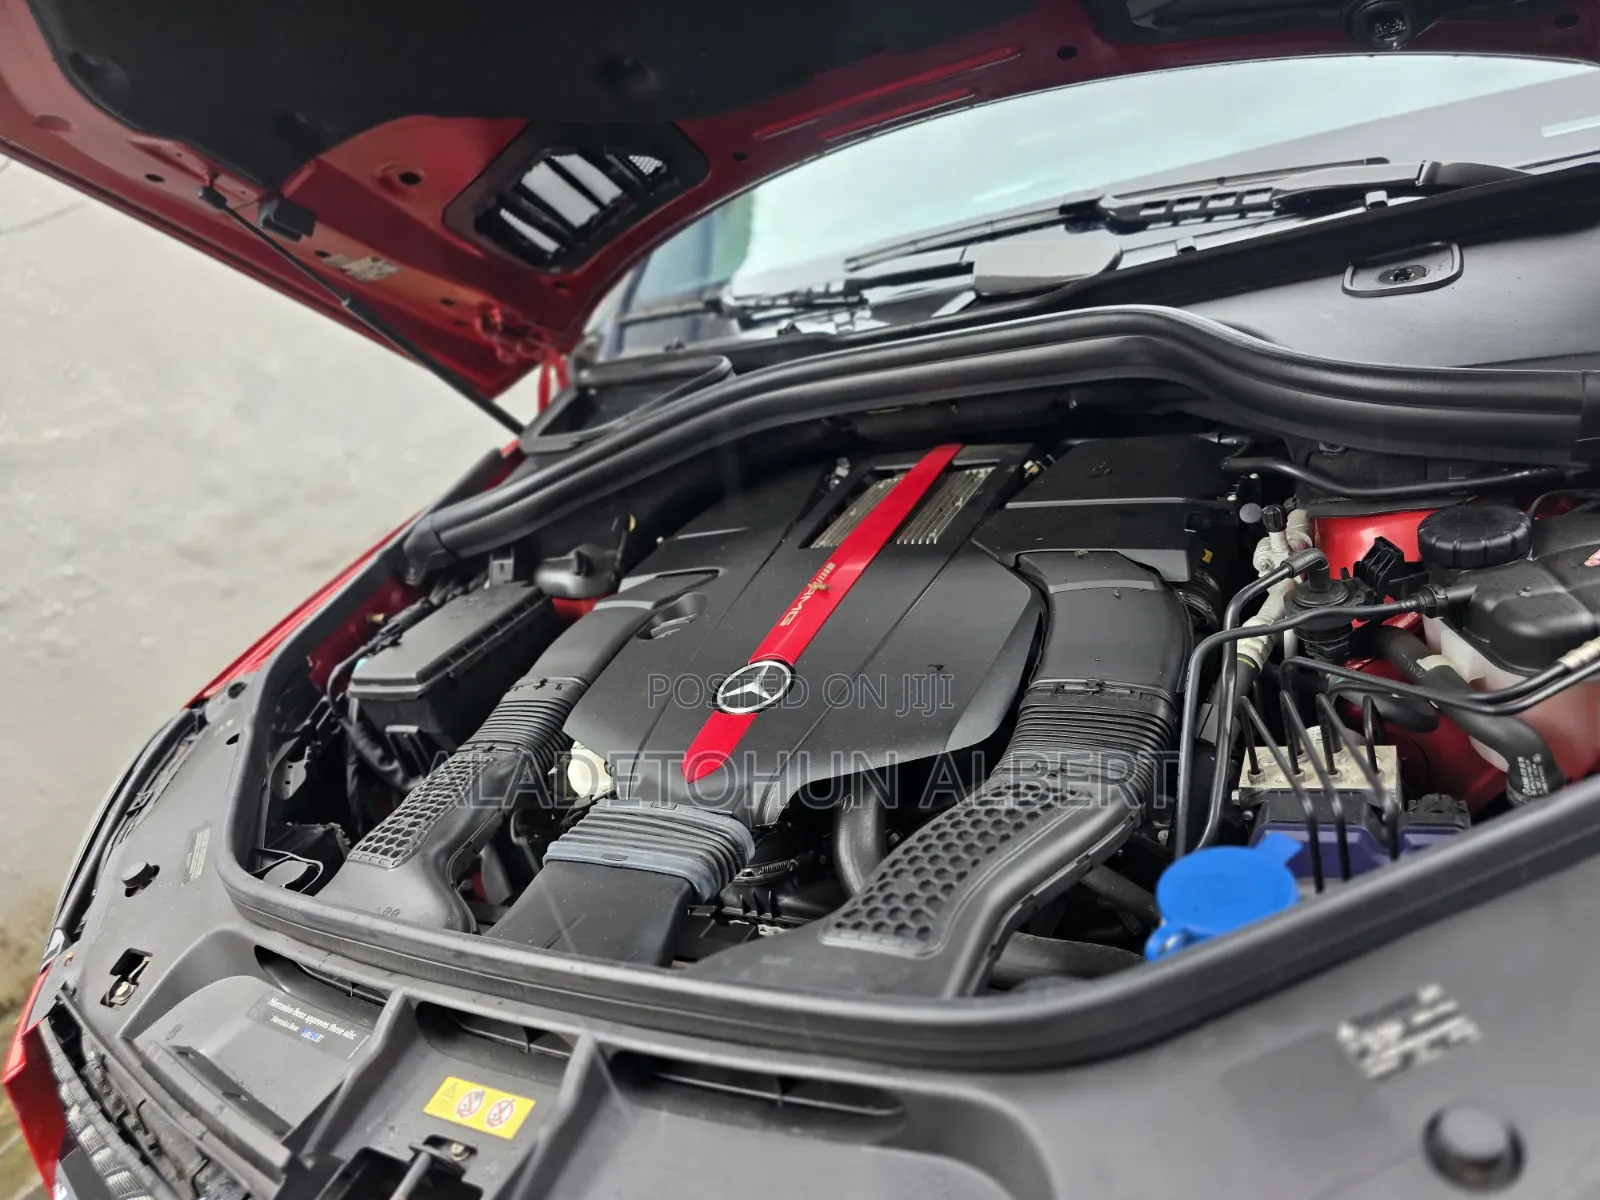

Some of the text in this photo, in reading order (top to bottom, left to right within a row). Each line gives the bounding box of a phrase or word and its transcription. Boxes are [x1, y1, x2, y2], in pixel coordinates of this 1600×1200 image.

[268, 997, 307, 1020] Mercedes-Benz
[304, 1014, 331, 1029] approves
[328, 1023, 345, 1036] these
